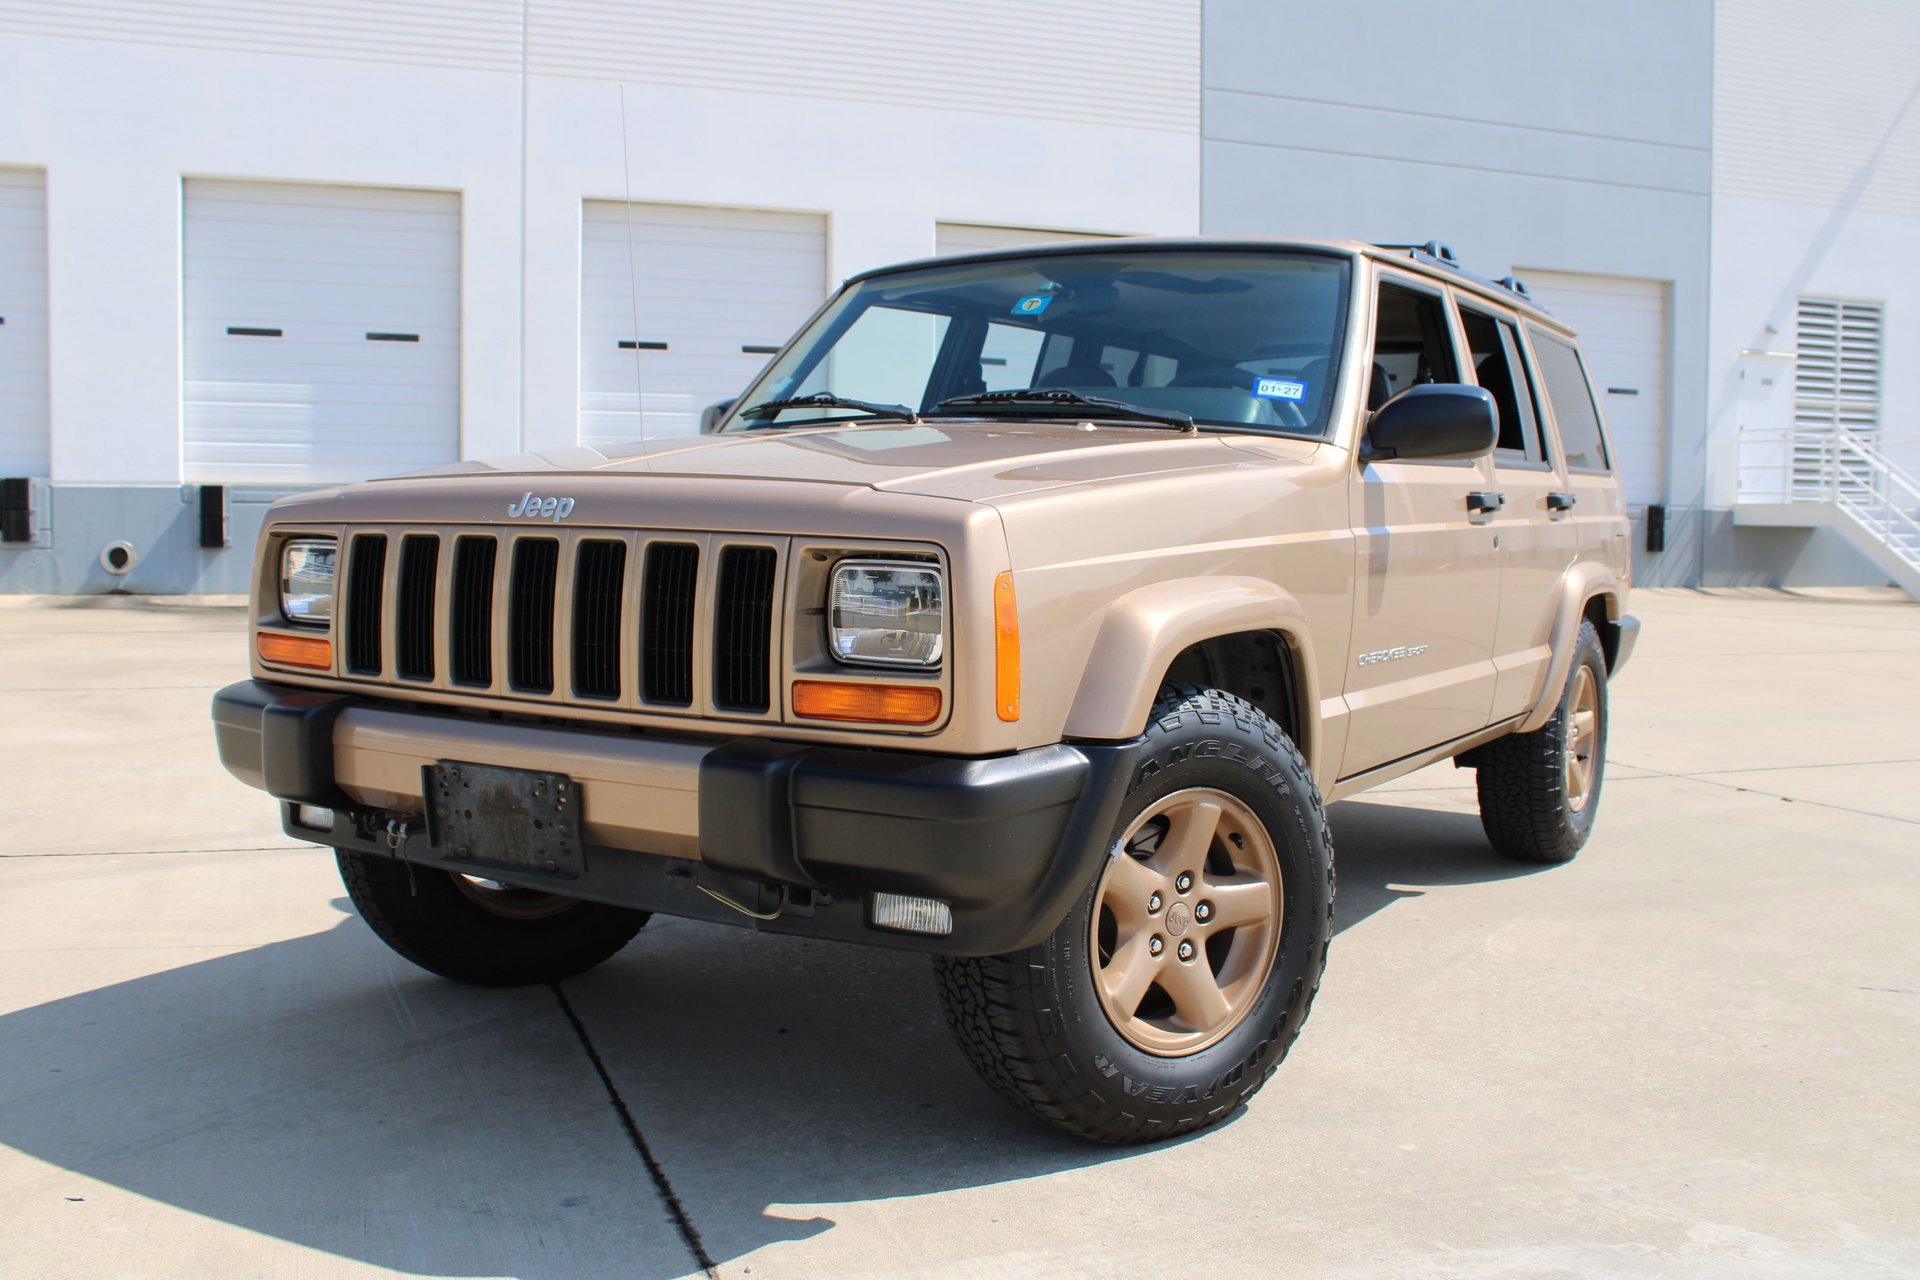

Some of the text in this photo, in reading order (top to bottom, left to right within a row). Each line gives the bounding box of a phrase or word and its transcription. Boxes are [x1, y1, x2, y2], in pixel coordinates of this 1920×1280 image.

[507, 491, 575, 523] Jeep
[1358, 645, 1428, 666] CHEROKEE SPORT
[1094, 977, 1304, 1105] GOODYEAR
